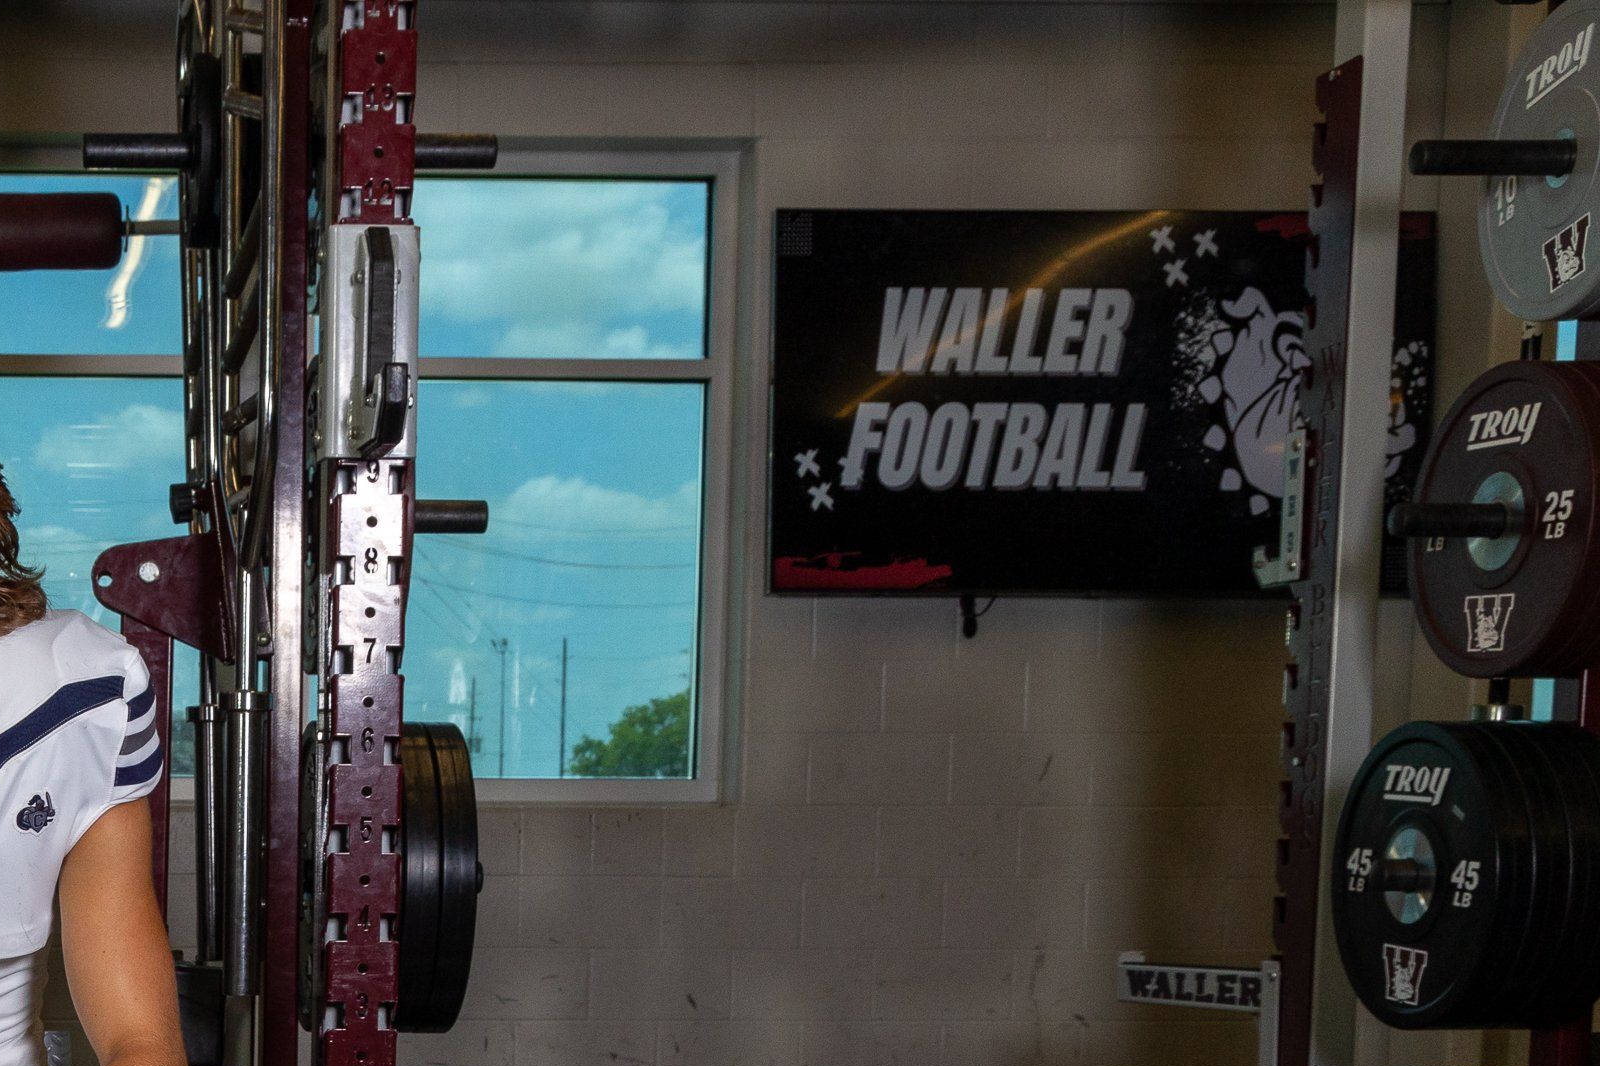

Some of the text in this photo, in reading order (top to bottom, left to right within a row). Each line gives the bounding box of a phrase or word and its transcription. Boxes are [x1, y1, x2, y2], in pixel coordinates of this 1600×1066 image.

[1525, 22, 1595, 104] TROY
[365, 83, 394, 111] 13
[363, 177, 393, 205] 12
[1495, 175, 1518, 210] 10
[1498, 204, 1515, 227] LB
[875, 286, 1134, 376] WALLER
[1467, 402, 1542, 449] TROY
[839, 400, 1149, 491] FOOTBALL
[366, 460, 380, 483] 9
[1542, 490, 1574, 522] 25
[1426, 537, 1445, 551] LB
[1544, 521, 1566, 539] LB
[364, 547, 378, 573] 8
[363, 638, 376, 663] 7
[361, 727, 374, 753] 6
[1383, 764, 1451, 806] TROY
[359, 816, 373, 843] 5
[1346, 848, 1373, 877] 45
[1450, 859, 1481, 891] 45
[1348, 876, 1366, 893] LB
[1452, 891, 1473, 908] LB
[357, 904, 371, 931] 4
[1127, 970, 1261, 1007] WALLER
